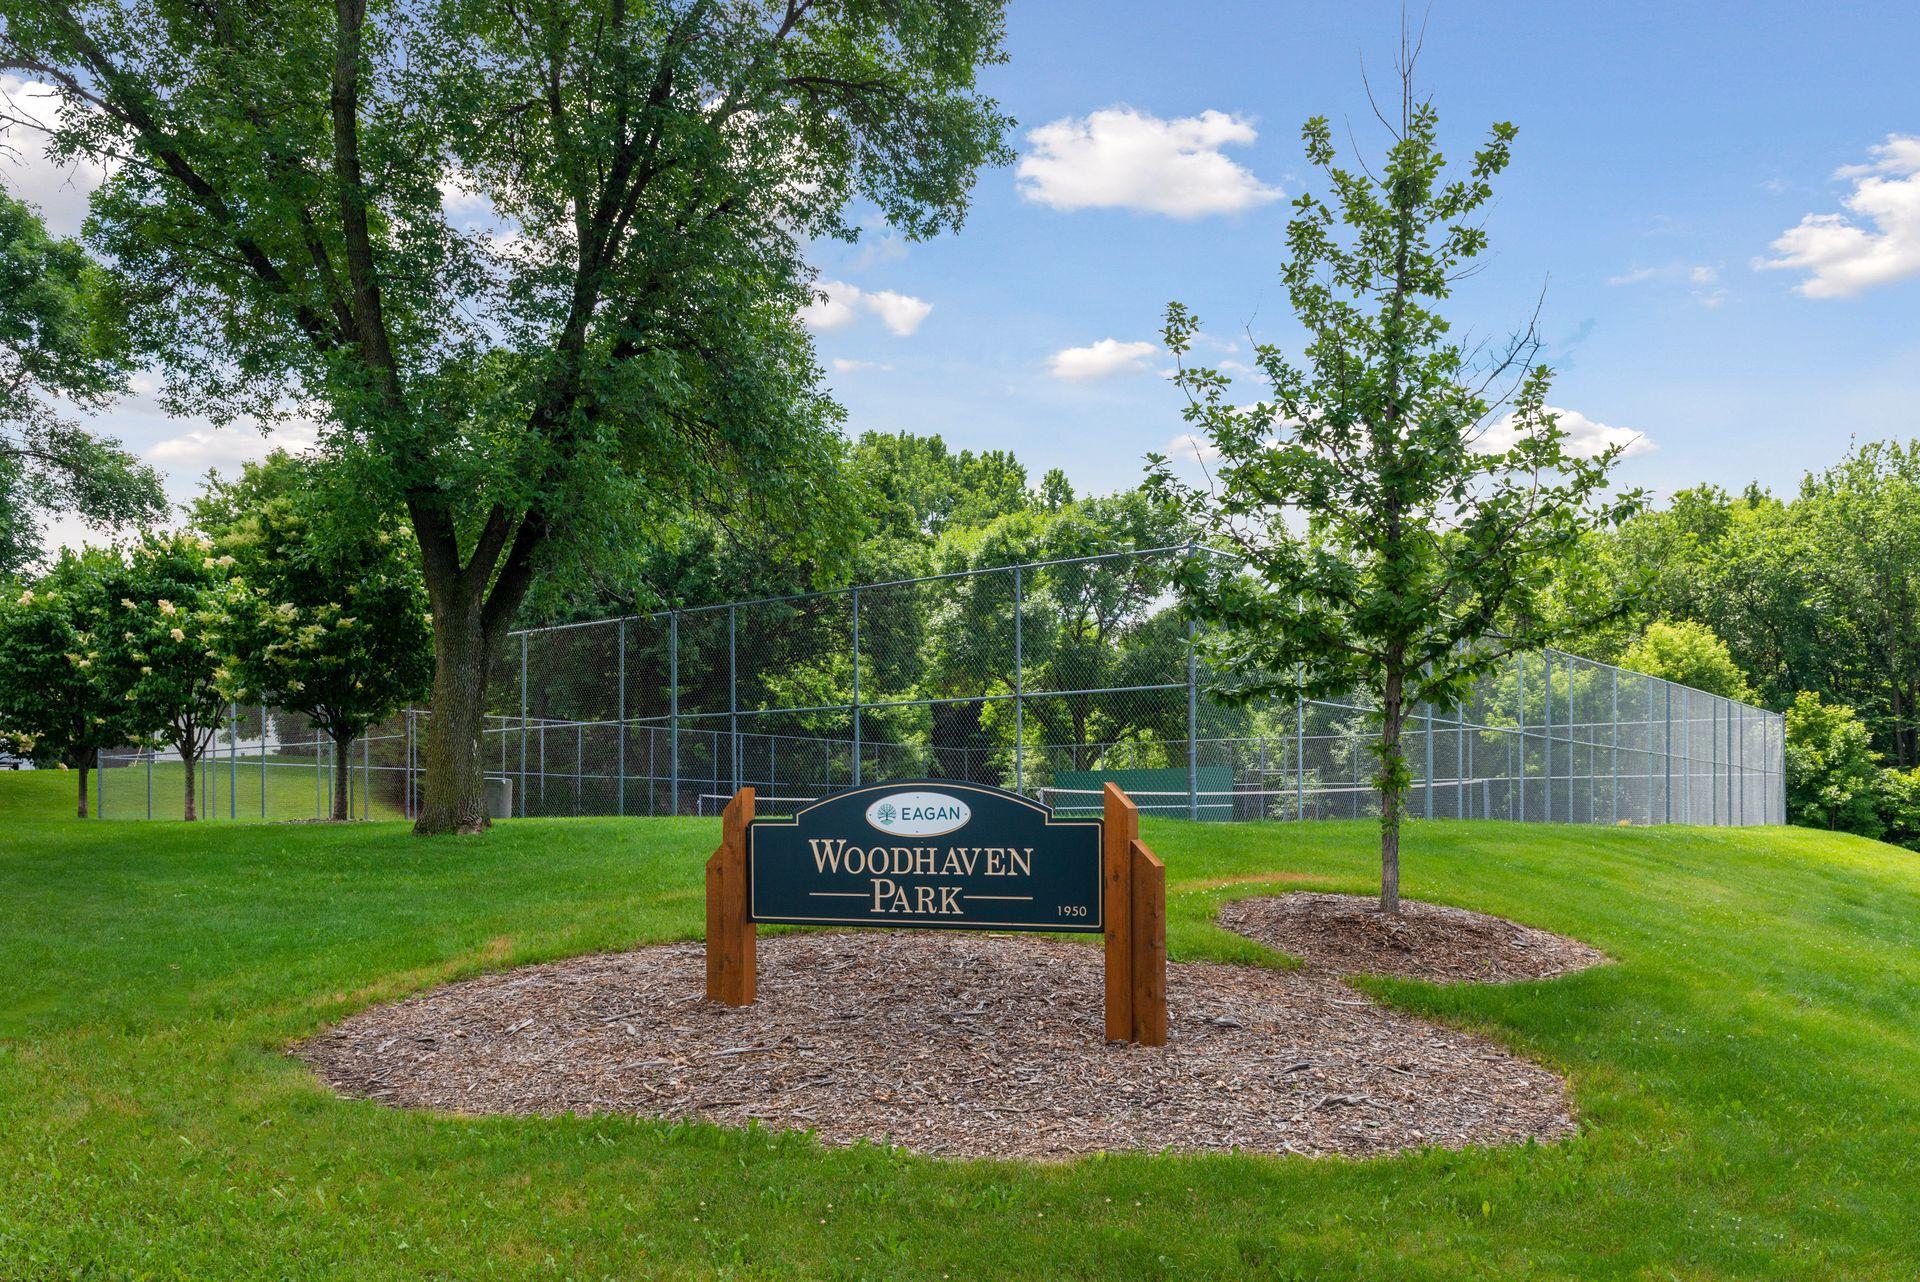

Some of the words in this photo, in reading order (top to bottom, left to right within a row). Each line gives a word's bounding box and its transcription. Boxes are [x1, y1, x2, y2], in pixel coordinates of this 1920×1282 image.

[901, 806, 961, 821] EAGAN
[808, 838, 1034, 876] WOODHAVEN
[870, 878, 964, 915] PARK
[1056, 905, 1088, 917] 1950
